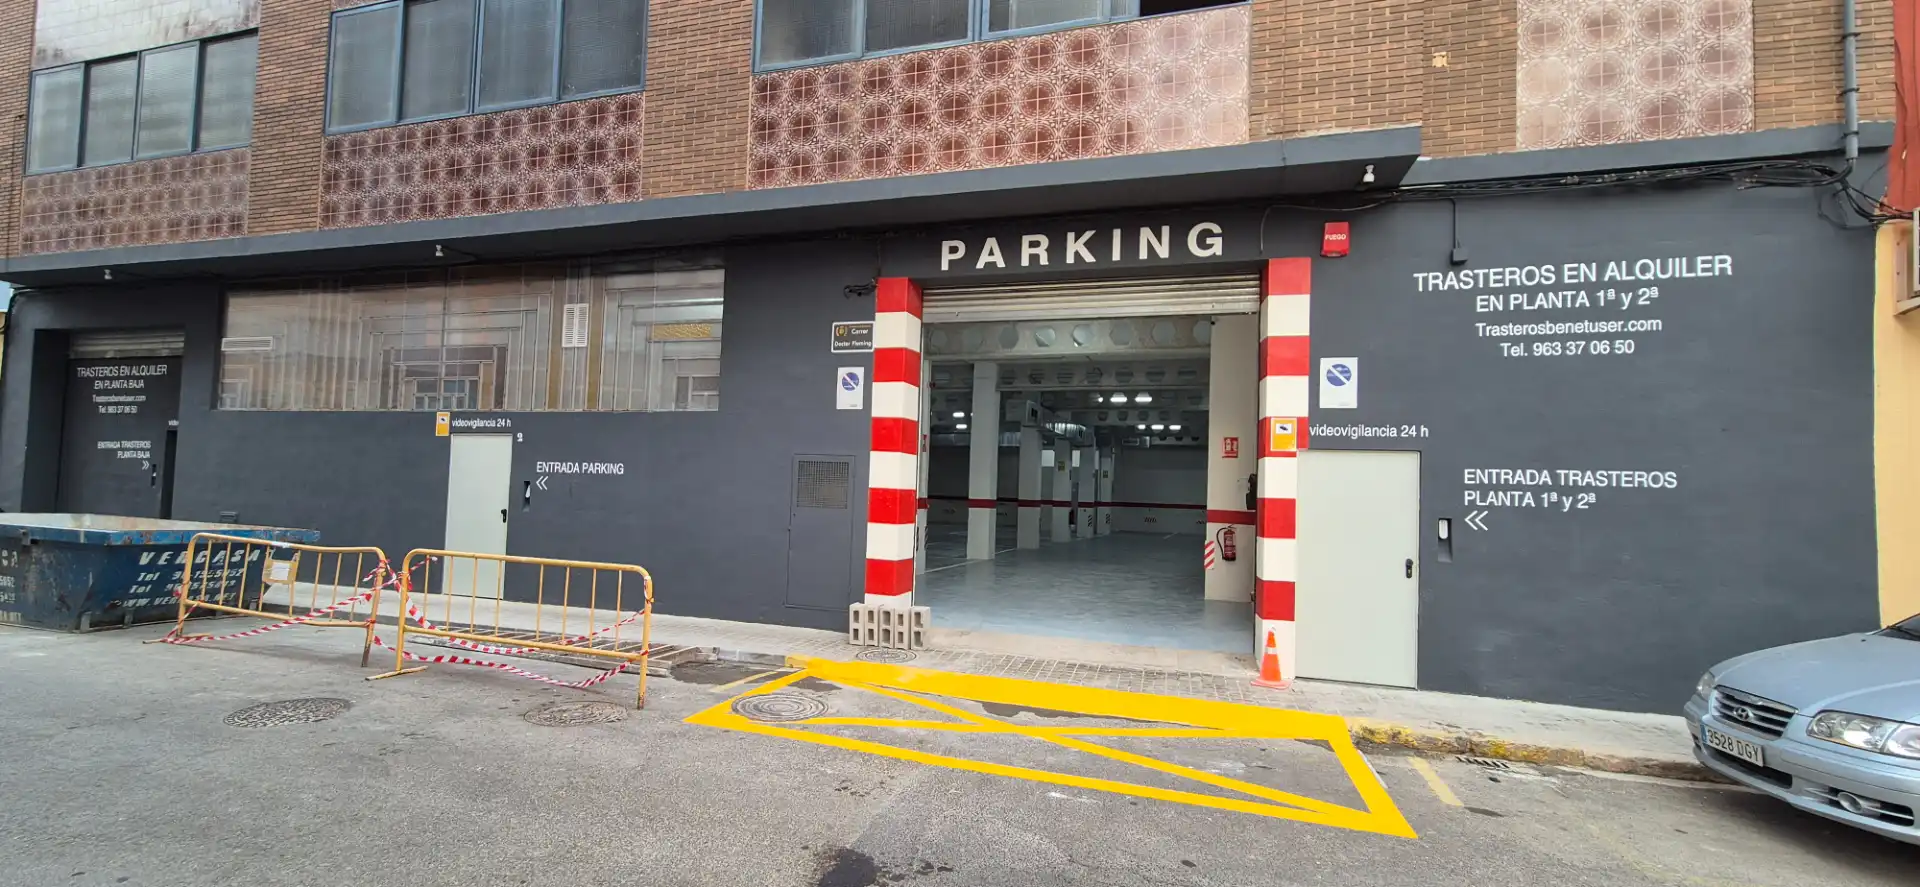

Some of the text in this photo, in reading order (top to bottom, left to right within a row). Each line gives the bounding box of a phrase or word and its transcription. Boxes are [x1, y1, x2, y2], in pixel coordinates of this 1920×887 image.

[1325, 233, 1347, 241] FUEGO
[941, 222, 1223, 271] PARKING
[1413, 255, 1732, 292] TRASTEROS EN ALQUILER
[1476, 286, 1659, 312] EN PLANTA 1ª y 2ª
[1475, 318, 1662, 337] Trasterosbenetuser.com
[1500, 340, 1635, 357] Tel. 963 37 06 50
[77, 365, 168, 377] TRASTEROS EN ALQUILER
[94, 380, 145, 389] EN PLANTA BAJA
[452, 417, 512, 429] videovigilancia 24 h
[1309, 425, 1429, 439] videovigilancia 24 h
[536, 461, 625, 474] ENTRADA PARKING
[1464, 468, 1678, 488] ENTRADA TRASTEROS
[1464, 491, 1596, 512] PLANTA 1ª y 2ª
[1707, 728, 1759, 762] 3528 DGY
